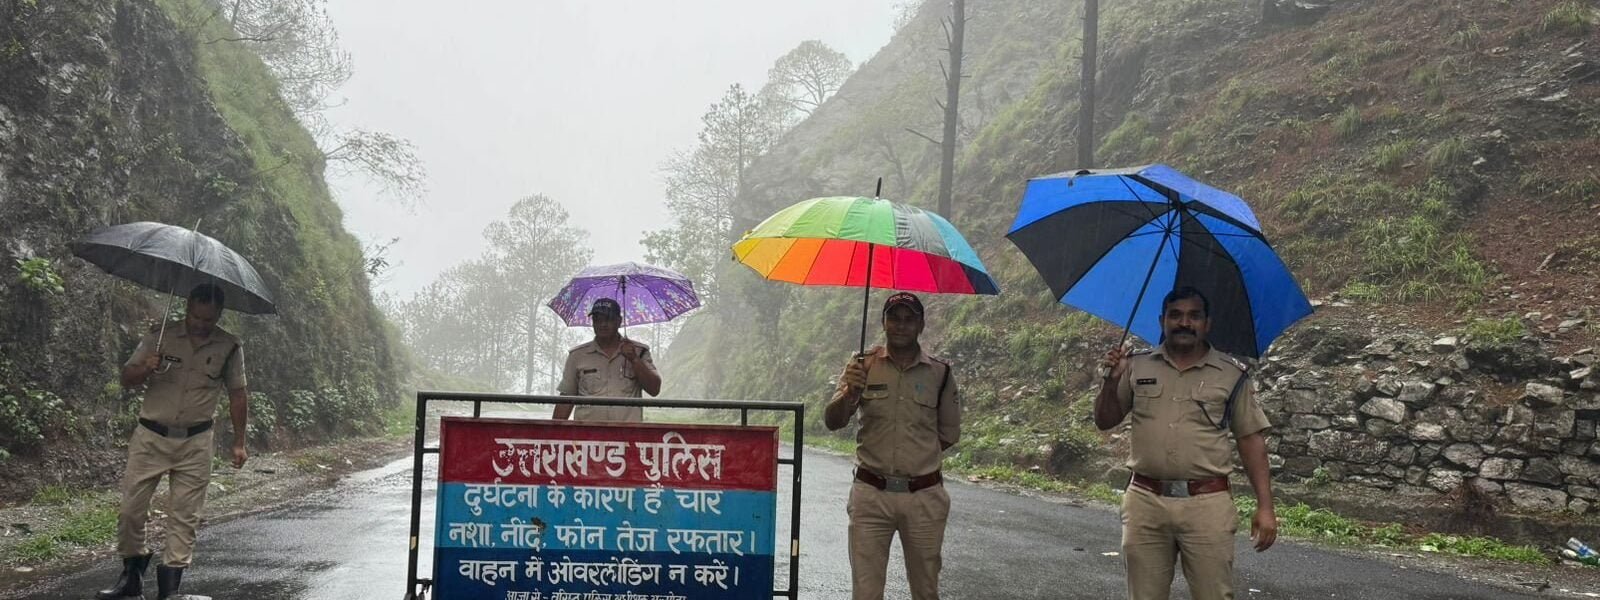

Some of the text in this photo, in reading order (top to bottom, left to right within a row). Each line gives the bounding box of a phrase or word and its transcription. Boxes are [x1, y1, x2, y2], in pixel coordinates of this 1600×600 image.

[492, 431, 726, 481] उत्तराखण्ड पुलिस
[464, 477, 724, 516] दुर्घटना के कारण हैं चार
[554, 518, 607, 550] फोन
[616, 520, 659, 552] तेज
[459, 559, 519, 586] वाहन
[524, 556, 545, 582] में
[547, 556, 662, 586] ओवरलोडिंग
[669, 564, 689, 585] न
